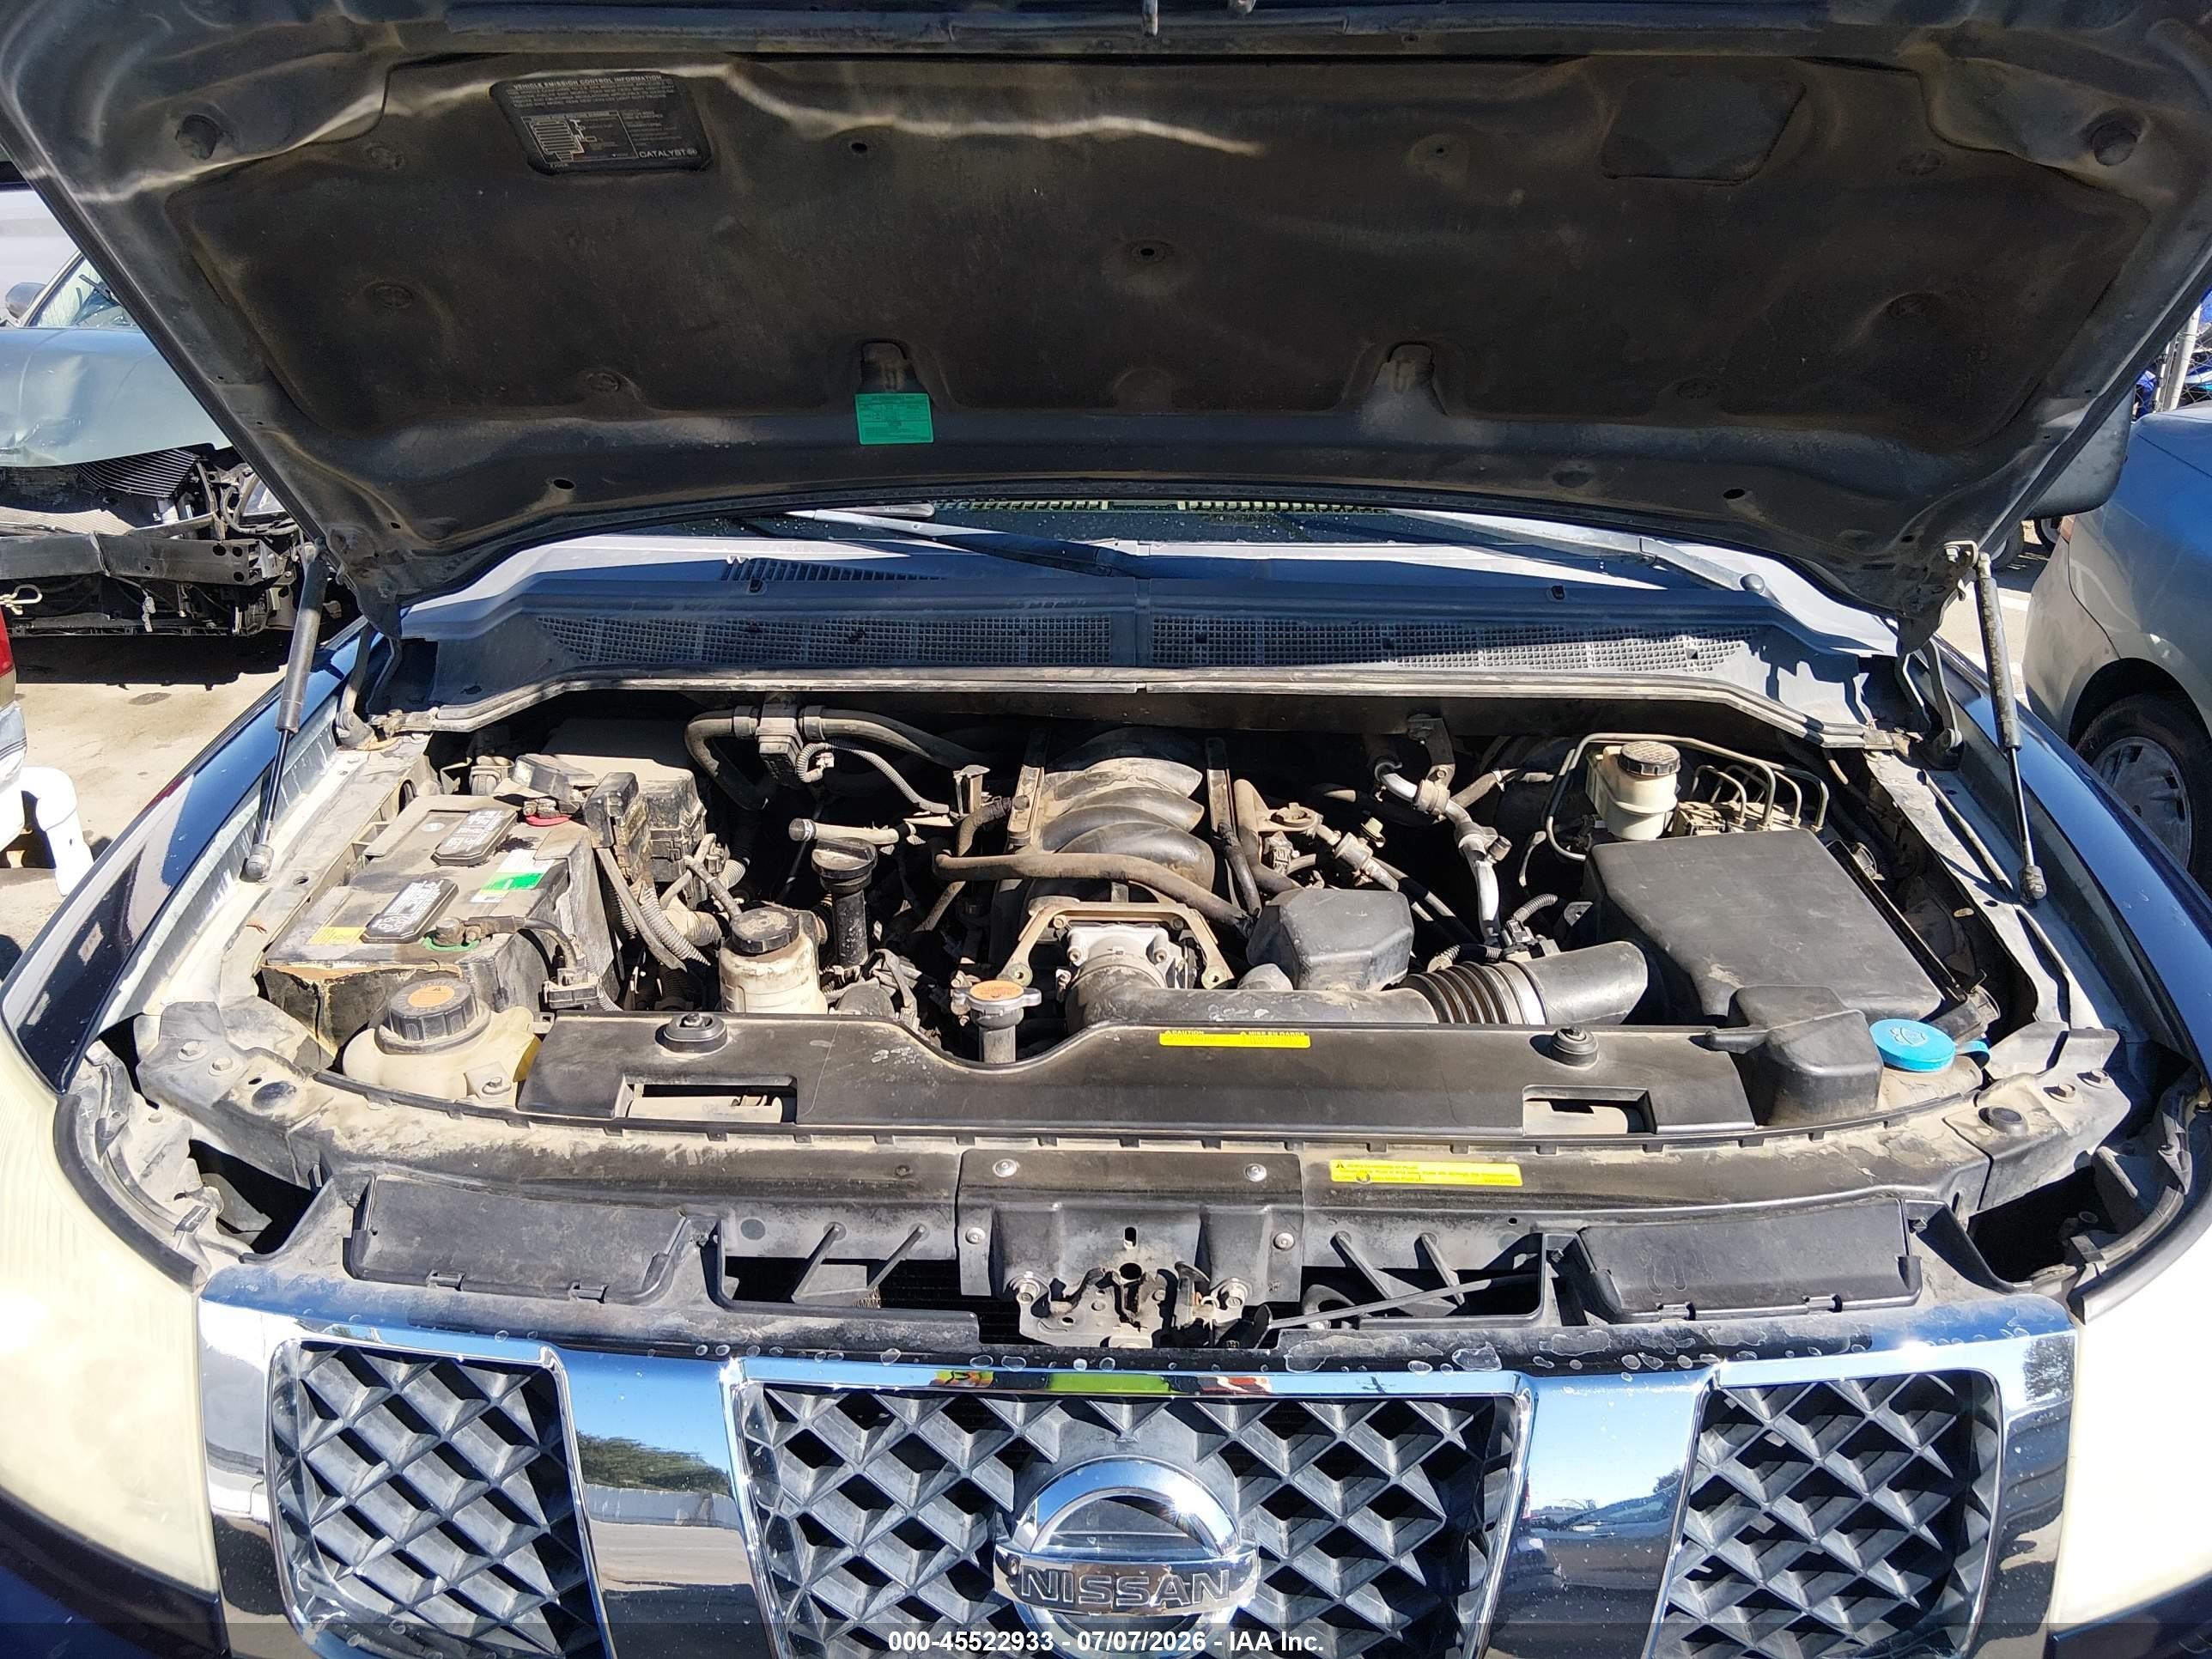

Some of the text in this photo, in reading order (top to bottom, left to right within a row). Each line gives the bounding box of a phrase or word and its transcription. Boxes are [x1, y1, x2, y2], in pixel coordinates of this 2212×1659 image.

[614, 75, 662, 83] INFORMATION
[639, 149, 686, 158] CATALYST
[1021, 1565, 1230, 1607] NISSAN
